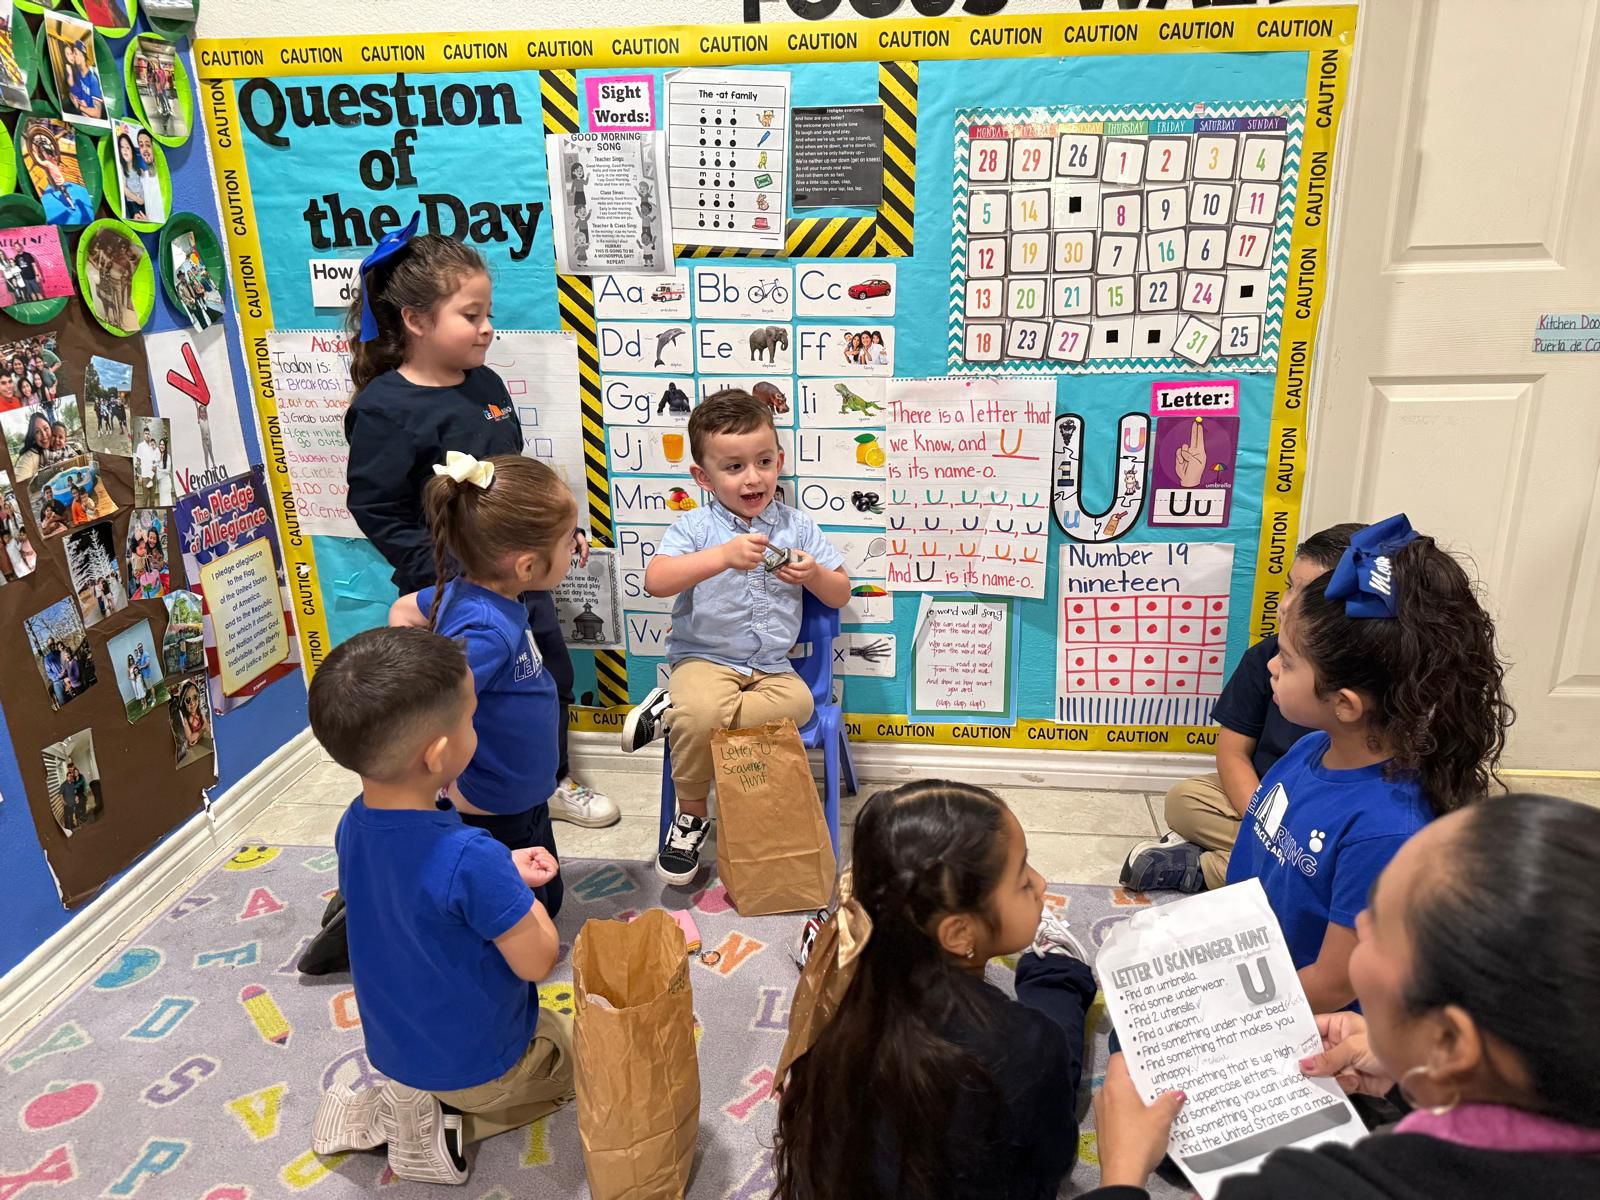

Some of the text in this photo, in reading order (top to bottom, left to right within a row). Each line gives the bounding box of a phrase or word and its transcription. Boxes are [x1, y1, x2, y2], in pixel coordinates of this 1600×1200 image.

[202, 20, 1333, 66] CAUTION CAUTION CAUTION CAUTION CAUTION CAUTION CAUTION CAUTION CAUTION CAUTION CAUTION CAUTION CAUTION
[602, 86, 641, 102] Sight
[699, 90, 713, 98] The
[731, 91, 758, 101] family
[239, 73, 521, 147] Question
[596, 108, 650, 124] Words:
[601, 132, 640, 140] MORNING
[1108, 123, 1144, 134] THURSDAY
[1158, 121, 1186, 132] FRIDAY
[1200, 120, 1236, 131] SATURDAY
[1248, 119, 1280, 130] SUNDAY
[360, 129, 416, 190] of
[979, 149, 998, 172] 28
[1022, 149, 1041, 172] 29
[1069, 144, 1088, 168] 26
[1120, 152, 1126, 174] 1
[1161, 149, 1171, 172] 2
[1209, 147, 1218, 170] 3
[1256, 148, 1266, 171] 4
[983, 203, 992, 224] 5
[1021, 200, 1038, 222] 14
[1162, 199, 1170, 220] 9
[1203, 193, 1220, 216] 10
[1250, 192, 1264, 214] 11
[304, 192, 543, 260] the Day
[1117, 204, 1126, 226] 8
[1022, 242, 1038, 264] 19
[1064, 242, 1083, 264] 30
[1113, 246, 1122, 267] 7
[1158, 240, 1174, 262] 16
[1201, 239, 1210, 260] 6
[1239, 234, 1256, 257] 17
[978, 248, 994, 269] 12
[314, 264, 352, 280] How
[600, 274, 642, 302] Aa
[699, 273, 739, 302] Bb
[800, 270, 841, 300] Cc
[1540, 314, 1576, 329] Kitchen
[602, 328, 641, 357] Dd
[700, 330, 733, 358] Ee
[800, 332, 832, 360] Ff
[1535, 338, 1582, 352] Puerta de
[272, 352, 330, 373] Today is:
[606, 382, 650, 424] Gg
[802, 386, 816, 414] Ii
[1161, 391, 1230, 408] Letter:
[888, 400, 1052, 424] There is a letter that
[614, 433, 642, 471] Jj
[890, 438, 908, 452] we
[958, 431, 986, 451] and
[1000, 428, 1022, 455] U
[888, 457, 996, 479] is its name-o.
[1277, 428, 1296, 492] CAUTION
[176, 463, 230, 493] Veronica
[193, 484, 254, 524] The Pledge
[615, 484, 666, 511] Mm
[802, 484, 844, 511] Oo
[1169, 492, 1212, 516] Uu
[190, 508, 267, 553] of Allegiance
[216, 564, 235, 580] pledge
[236, 550, 262, 570] allegiance
[1070, 544, 1188, 566] Number 19
[888, 561, 1034, 588] And U is its name-o.
[1069, 570, 1180, 593] nineteen
[962, 604, 978, 616] wall
[631, 620, 661, 644] Vv
[878, 724, 1088, 741] CAUTION CAUTION CAUTION
[720, 745, 752, 760] Letter
[740, 772, 768, 792] Hunt
[240, 888, 284, 920] A
[1112, 926, 1270, 990] LETTER U SCAVENGER HUNT
[1236, 956, 1276, 1005] U
[1125, 990, 1143, 1001] Find
[1144, 986, 1156, 996] an
[1130, 1003, 1147, 1015] Find
[1148, 996, 1174, 1010] some
[1134, 1016, 1152, 1029] Find
[1152, 1012, 1158, 1022] 2
[1138, 1030, 1156, 1043] Find
[1158, 1028, 1163, 1036] a
[1142, 1044, 1160, 1057] Find
[1162, 1025, 1211, 1052] something
[1211, 1018, 1238, 1033] under
[1240, 1010, 1263, 1024] your
